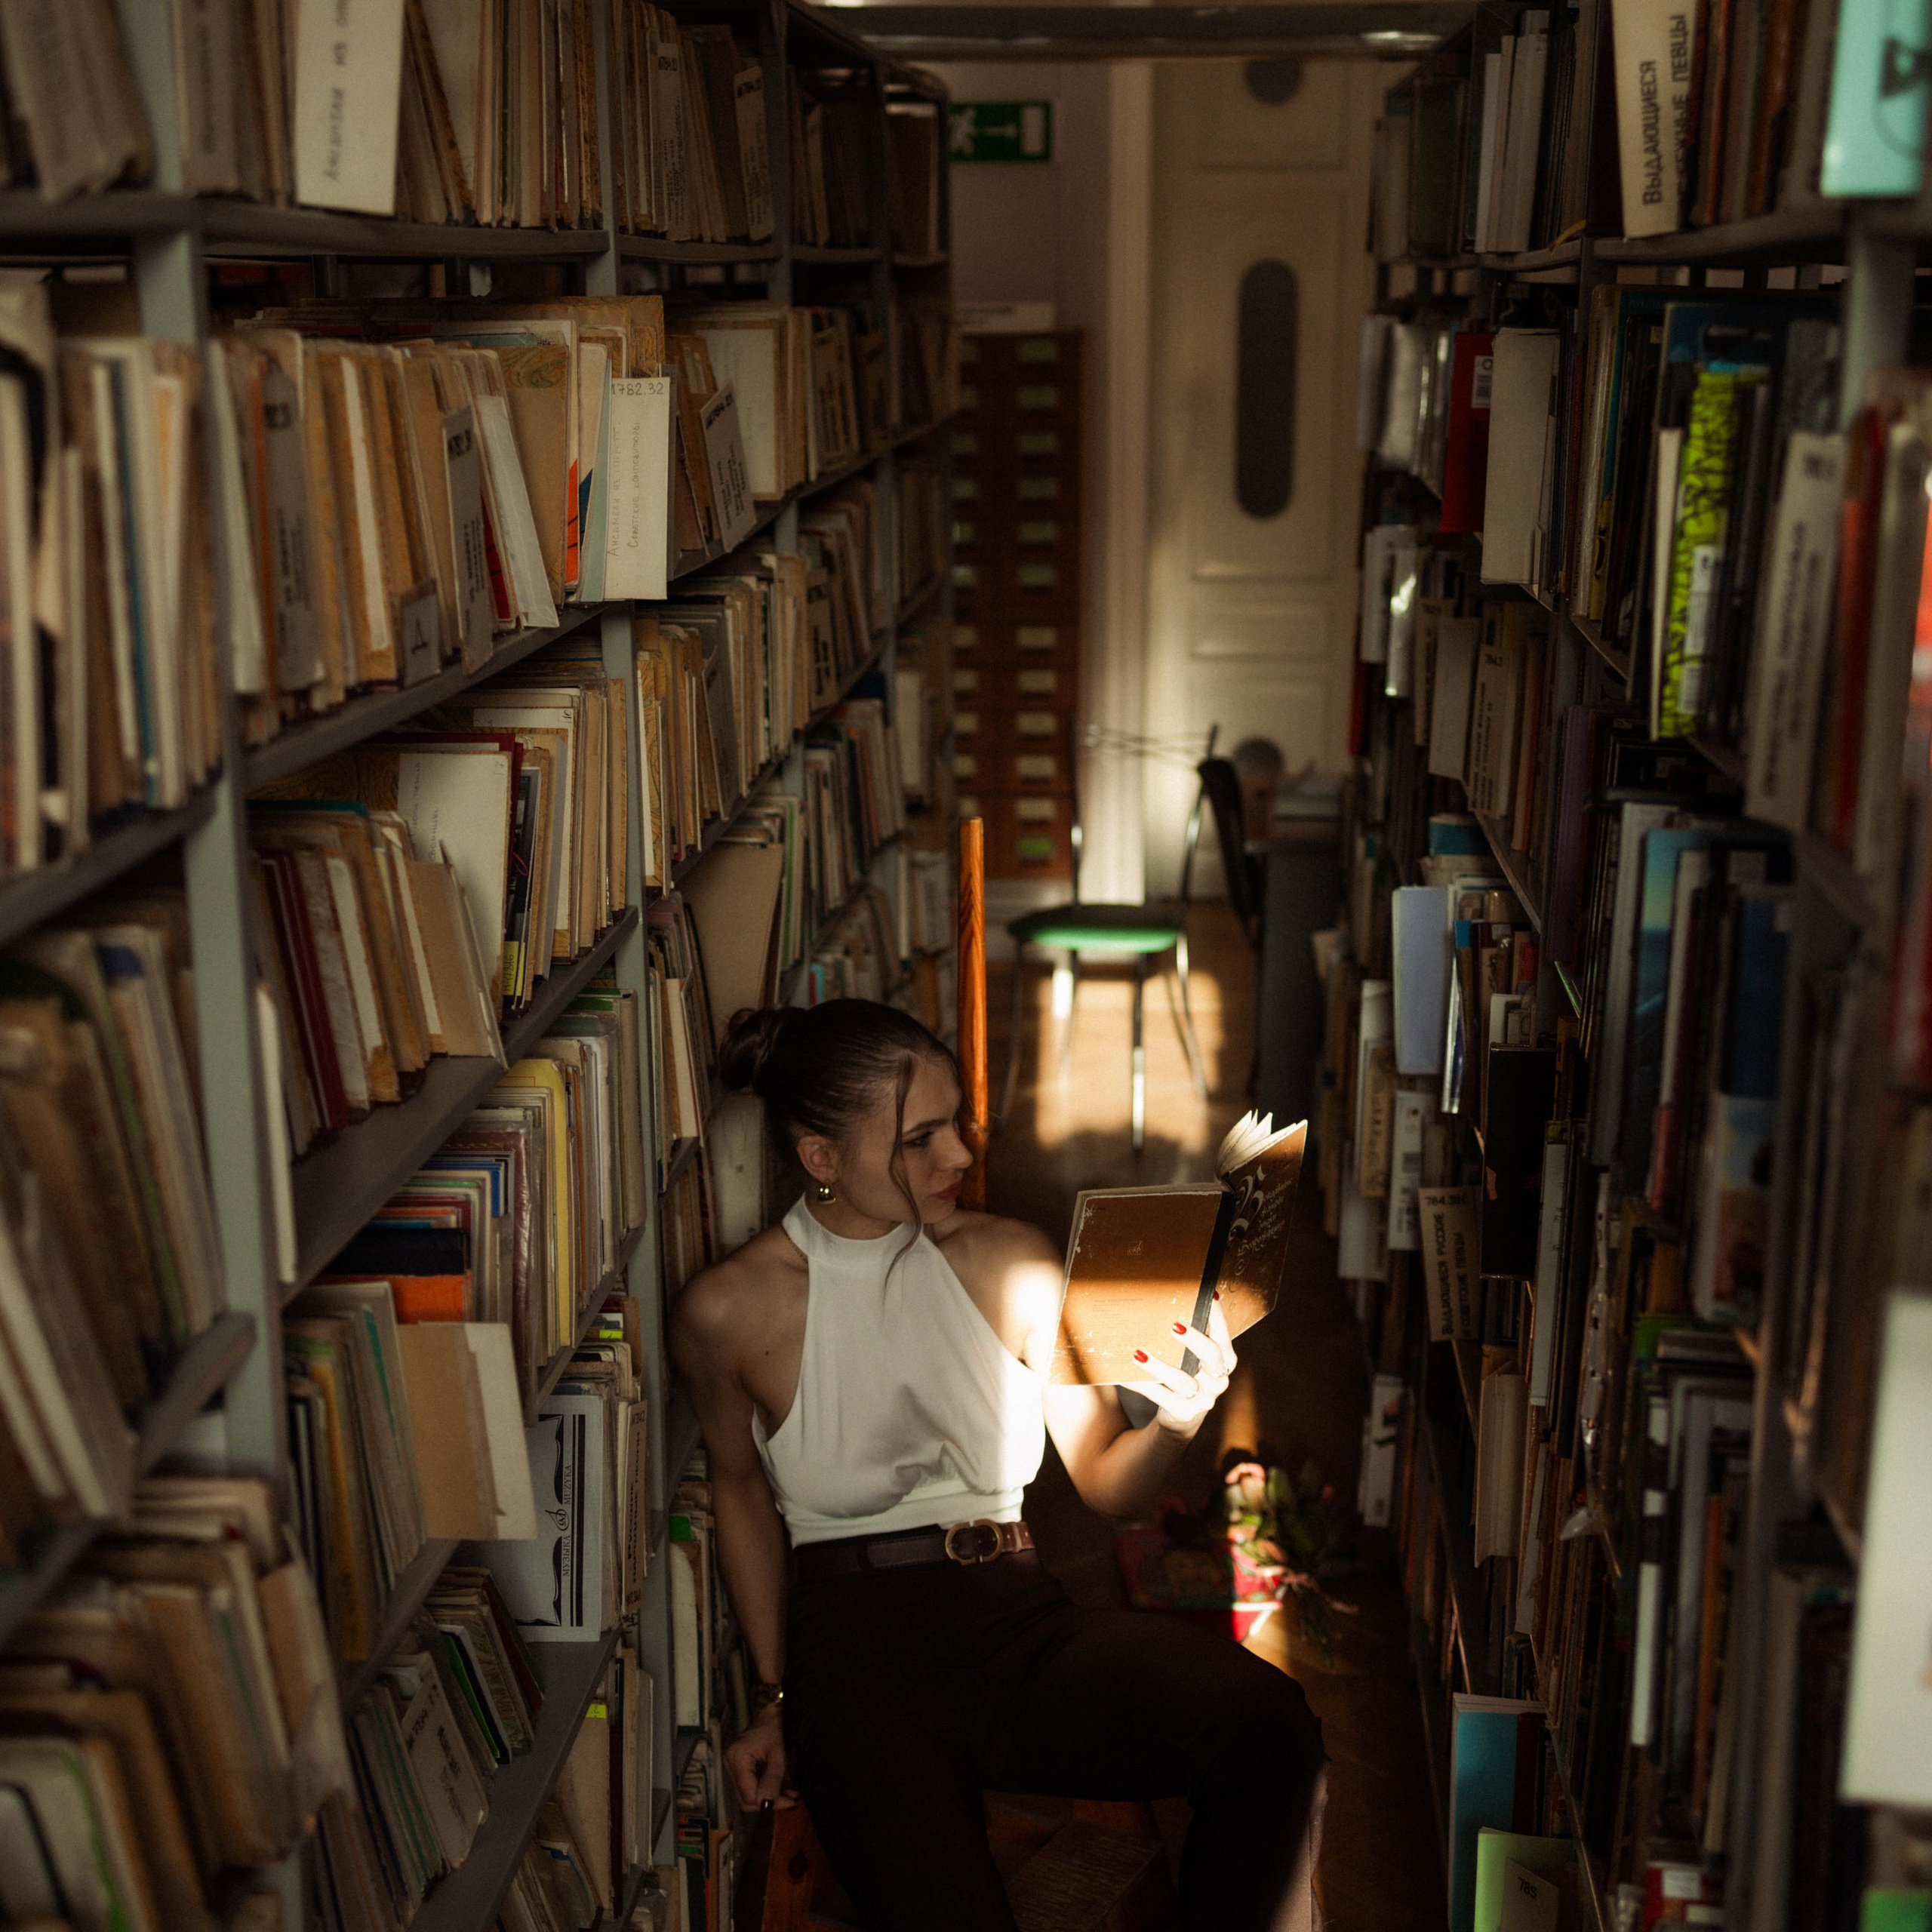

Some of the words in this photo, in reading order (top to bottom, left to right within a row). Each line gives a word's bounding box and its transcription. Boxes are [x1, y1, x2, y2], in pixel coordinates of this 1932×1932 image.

[1669, 14, 1690, 83] ПЕВЦЫ
[562, 1534, 571, 1577] МУЗЫКА
[1518, 1877, 1537, 1899] 785
